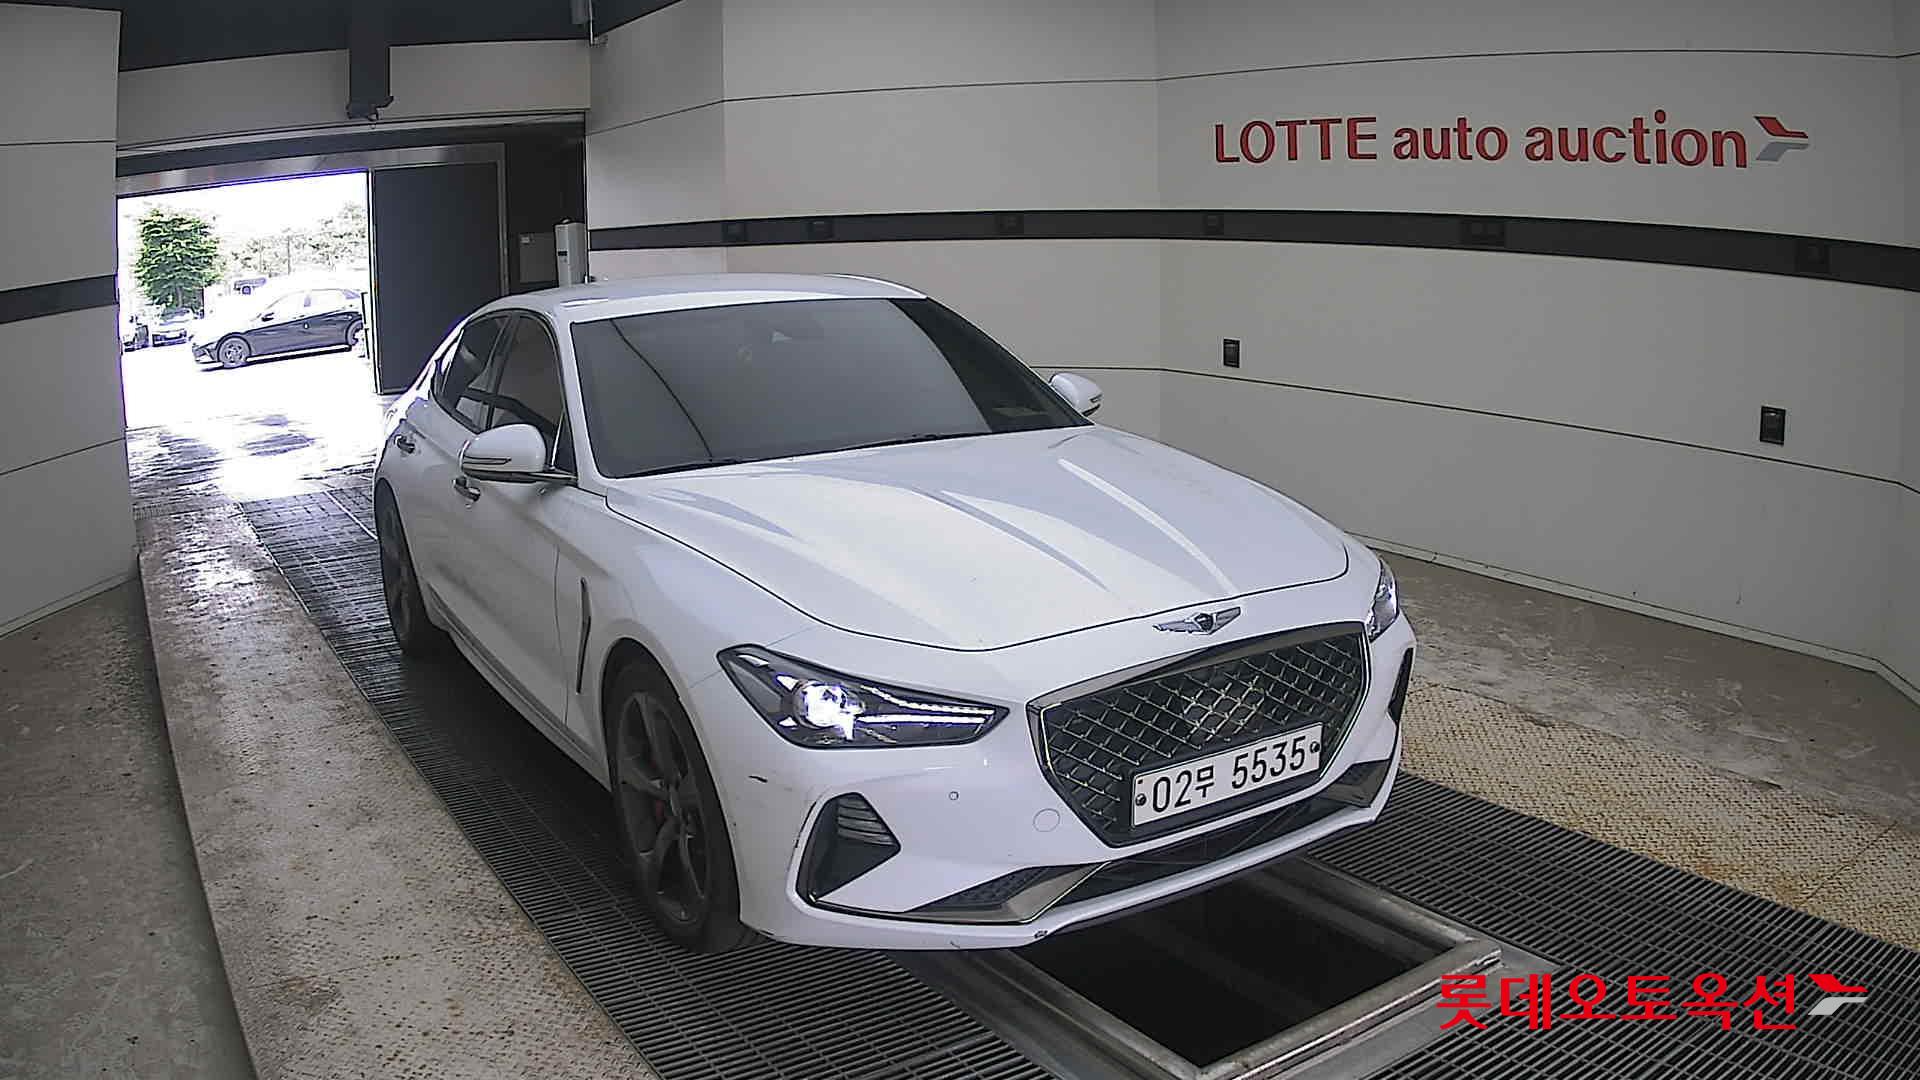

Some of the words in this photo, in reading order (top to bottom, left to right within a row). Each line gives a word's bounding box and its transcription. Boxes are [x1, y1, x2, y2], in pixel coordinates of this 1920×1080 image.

[1214, 116, 1378, 164] LOTTE
[1393, 116, 1509, 162] auto
[1524, 109, 1748, 169] auction
[1152, 765, 1215, 813] 02무
[1231, 735, 1307, 789] 5535
